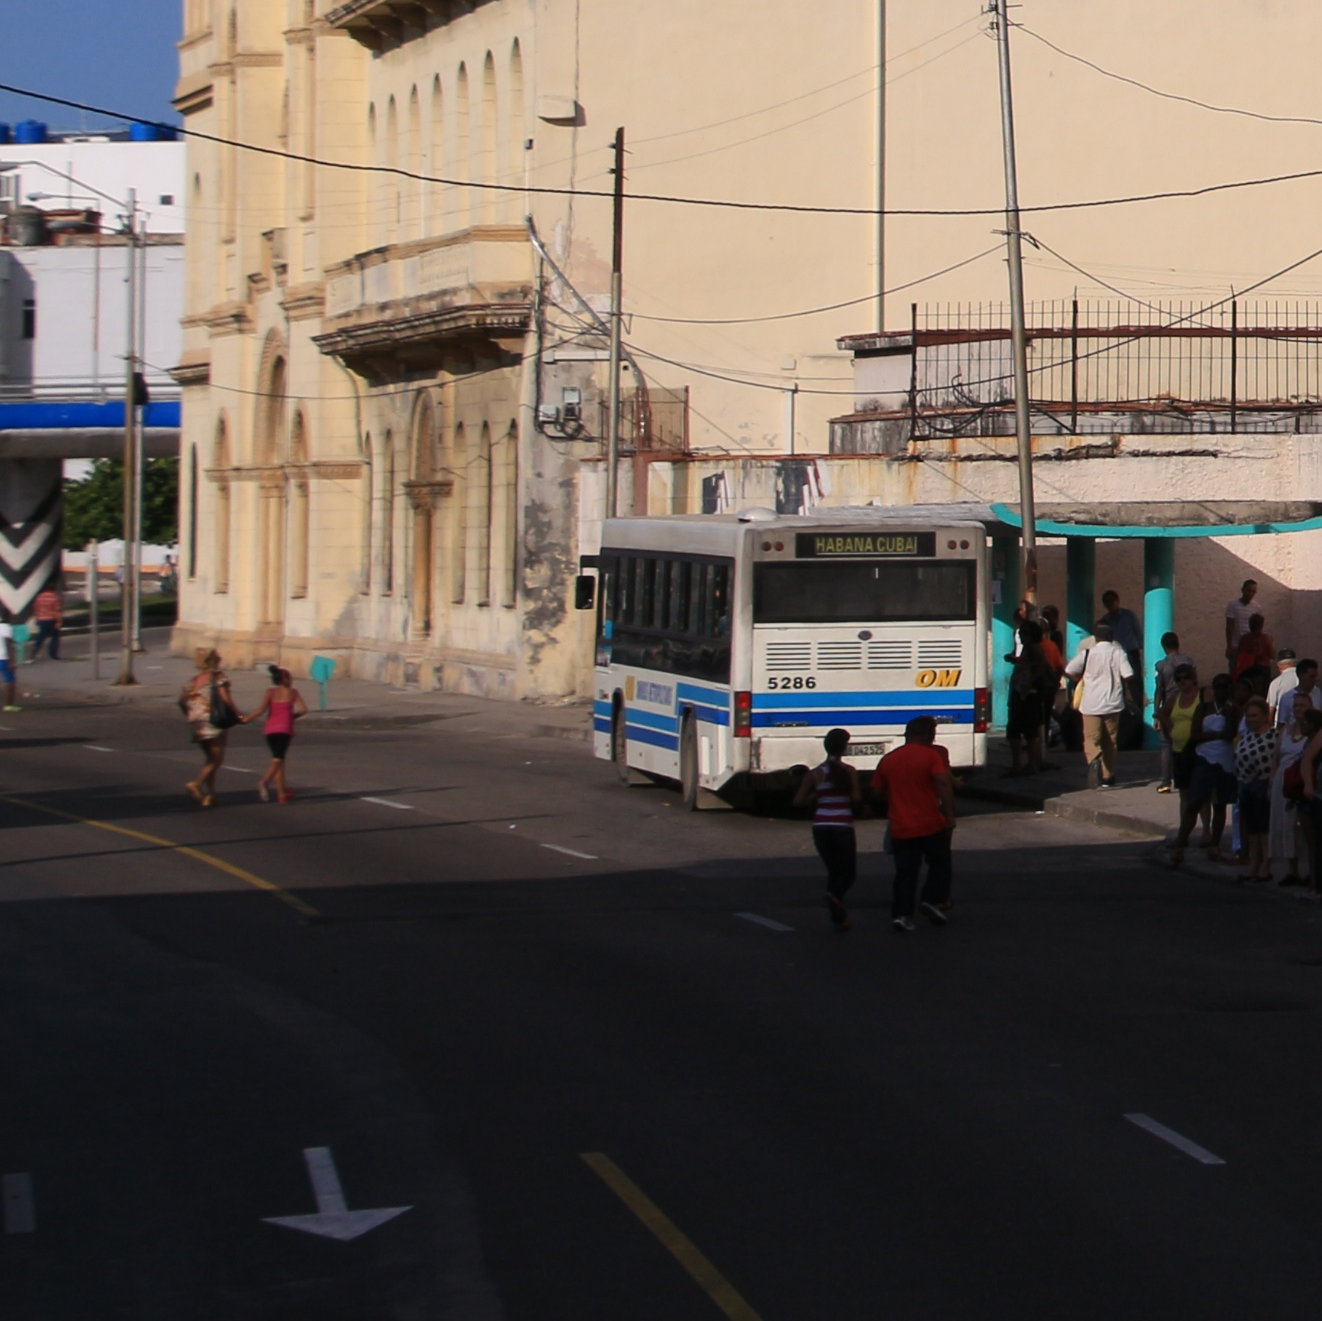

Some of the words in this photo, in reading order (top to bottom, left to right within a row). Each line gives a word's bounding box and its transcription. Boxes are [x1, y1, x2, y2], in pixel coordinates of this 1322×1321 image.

[816, 537, 873, 552] HABANA
[877, 537, 914, 552] CUBA
[767, 677, 816, 689] 5286
[915, 669, 962, 688] OM
